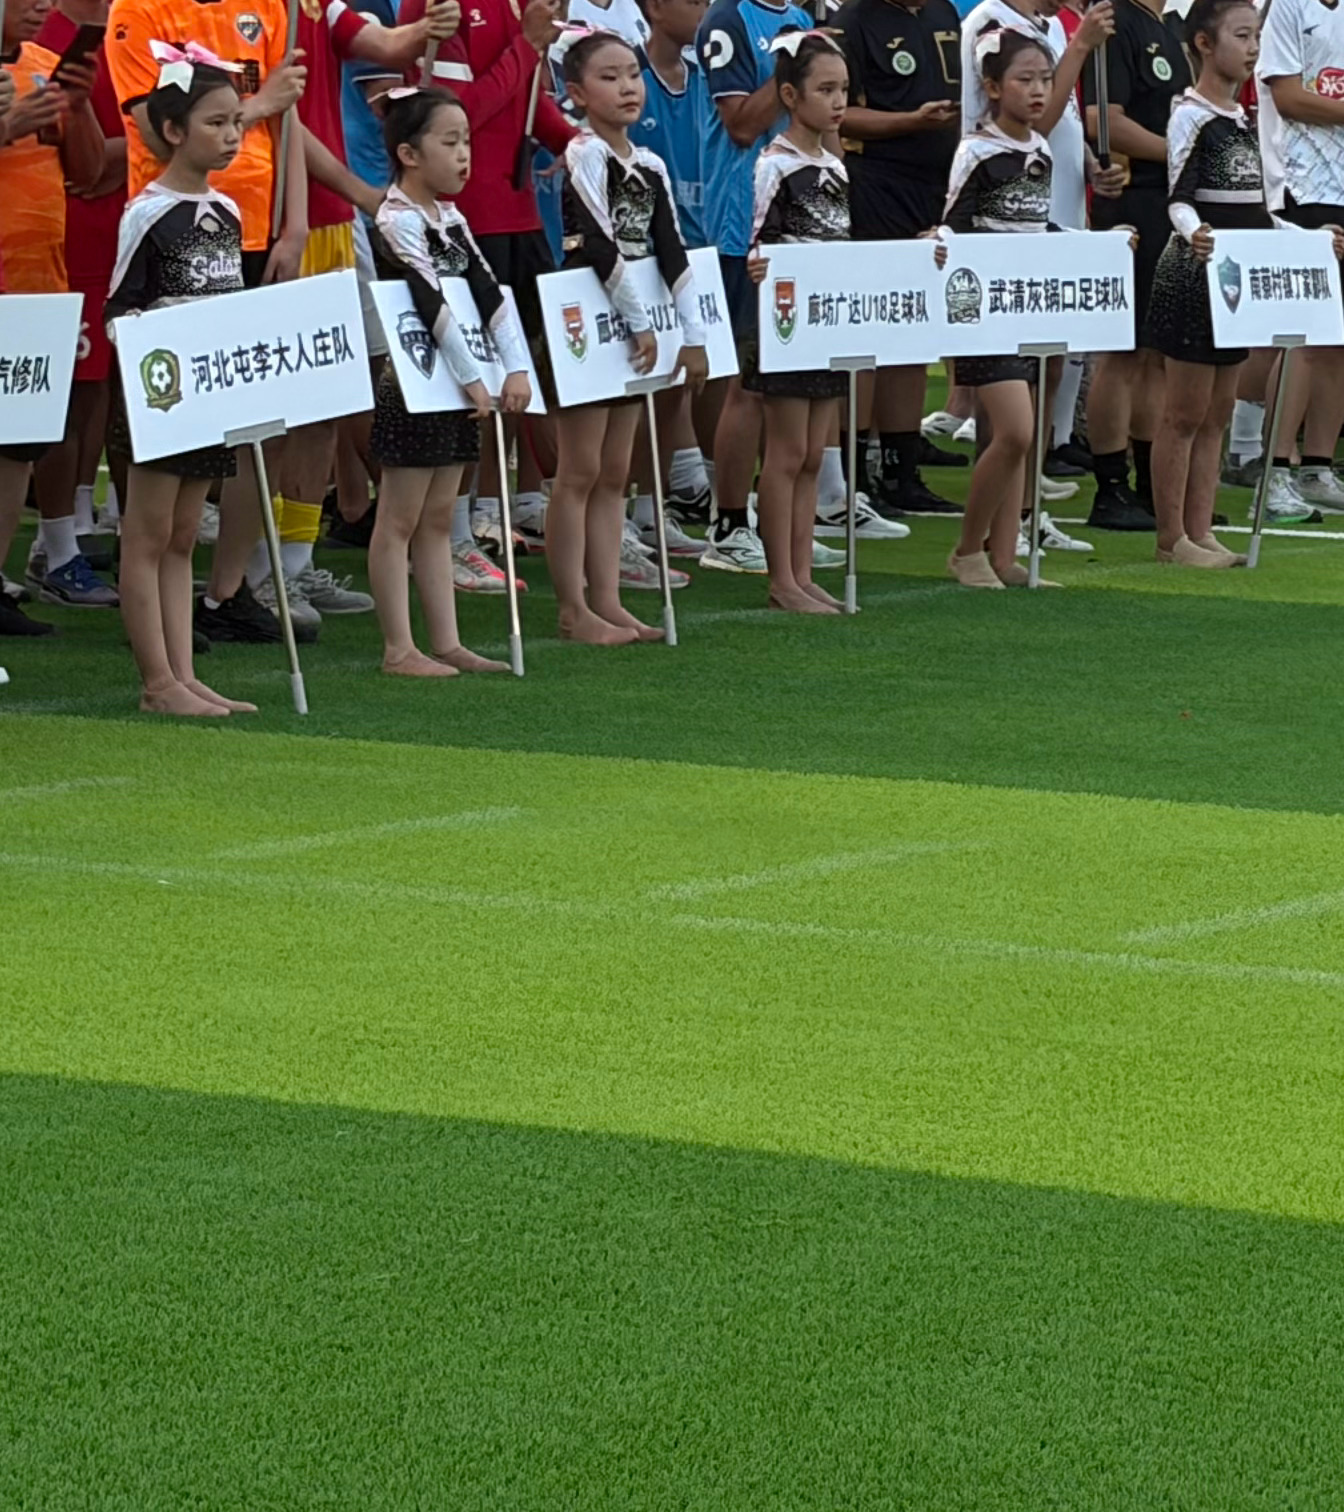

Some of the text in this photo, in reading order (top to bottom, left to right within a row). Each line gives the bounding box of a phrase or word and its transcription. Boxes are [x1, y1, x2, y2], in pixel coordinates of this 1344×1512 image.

[807, 290, 930, 327] 廊坊广达U18足球队
[988, 277, 1129, 315] 武清灰锅口足球队
[191, 324, 355, 394] 河北屯李大人庄队
